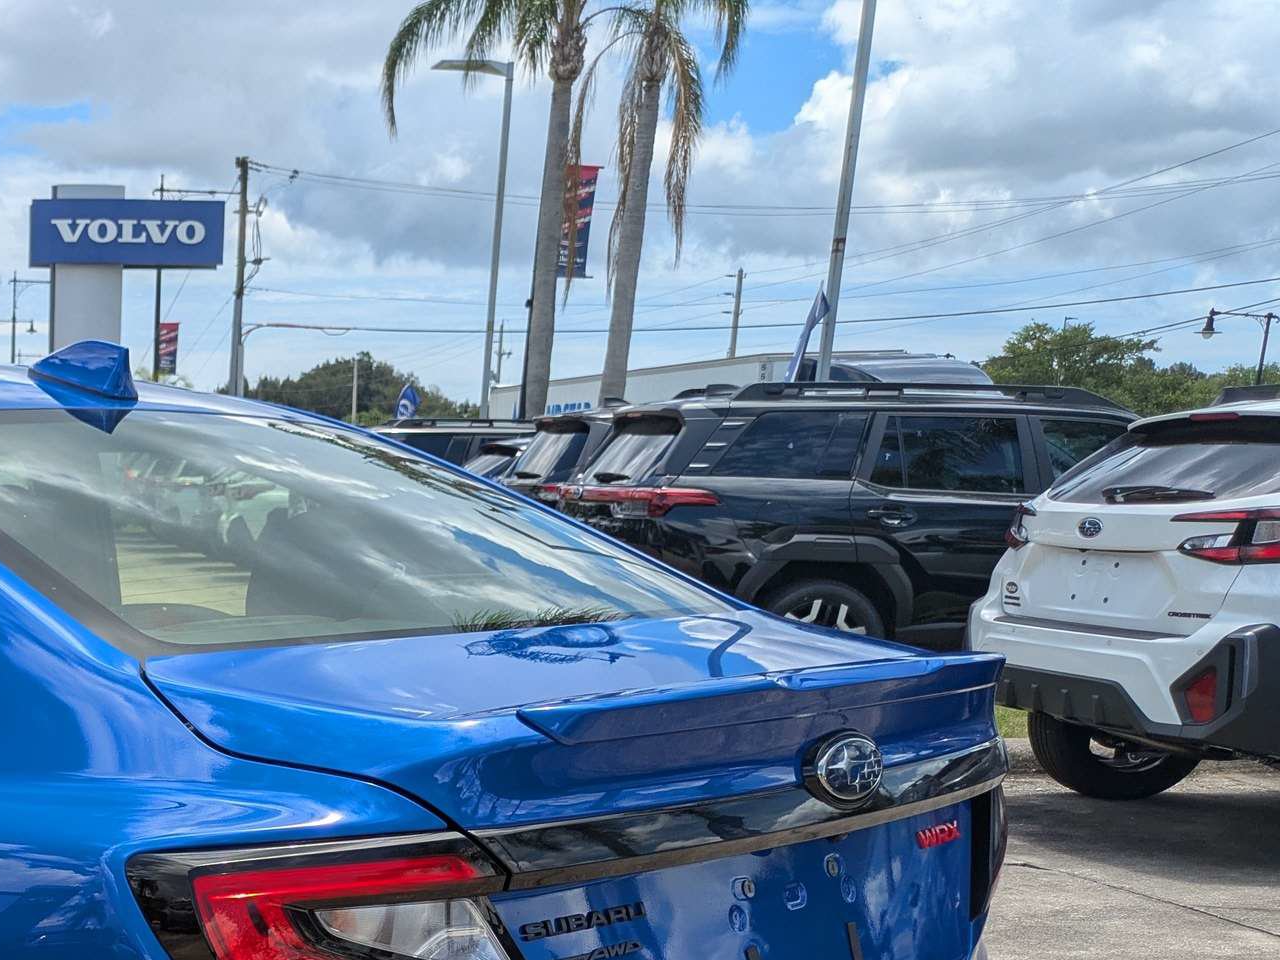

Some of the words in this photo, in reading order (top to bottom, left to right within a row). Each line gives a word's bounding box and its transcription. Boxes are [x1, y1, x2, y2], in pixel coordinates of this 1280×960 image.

[51, 218, 206, 244] VOLVO
[915, 820, 961, 849] WRX
[519, 901, 647, 941] SUBARU
